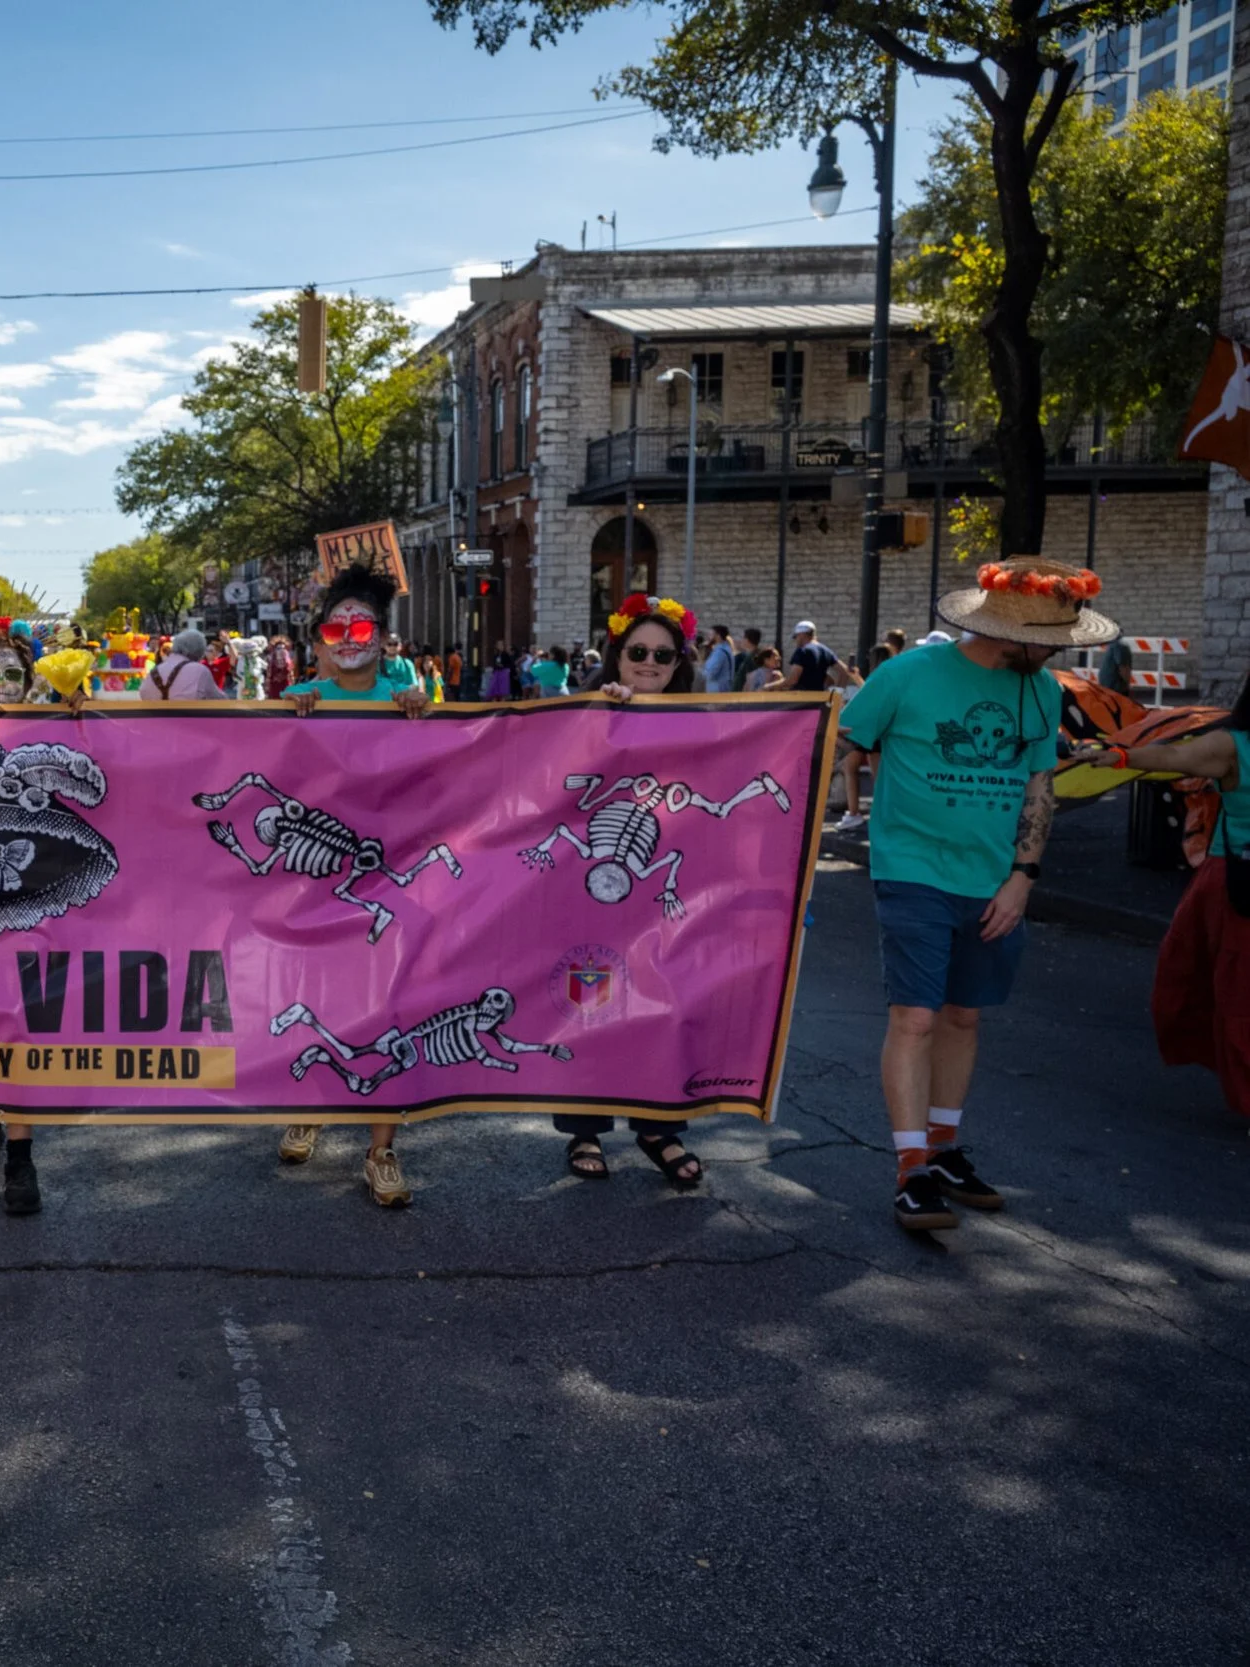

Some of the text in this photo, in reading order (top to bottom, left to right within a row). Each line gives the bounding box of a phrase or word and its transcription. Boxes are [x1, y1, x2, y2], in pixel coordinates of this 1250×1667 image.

[797, 453, 840, 465] TRINITY
[927, 773, 955, 782] VIVA
[959, 774, 974, 784] LA
[978, 776, 1005, 785] VIDA
[16, 950, 234, 1033] VIDA
[26, 1048, 53, 1071] OF
[61, 1048, 103, 1070] THE
[115, 1048, 200, 1080] DEAD
